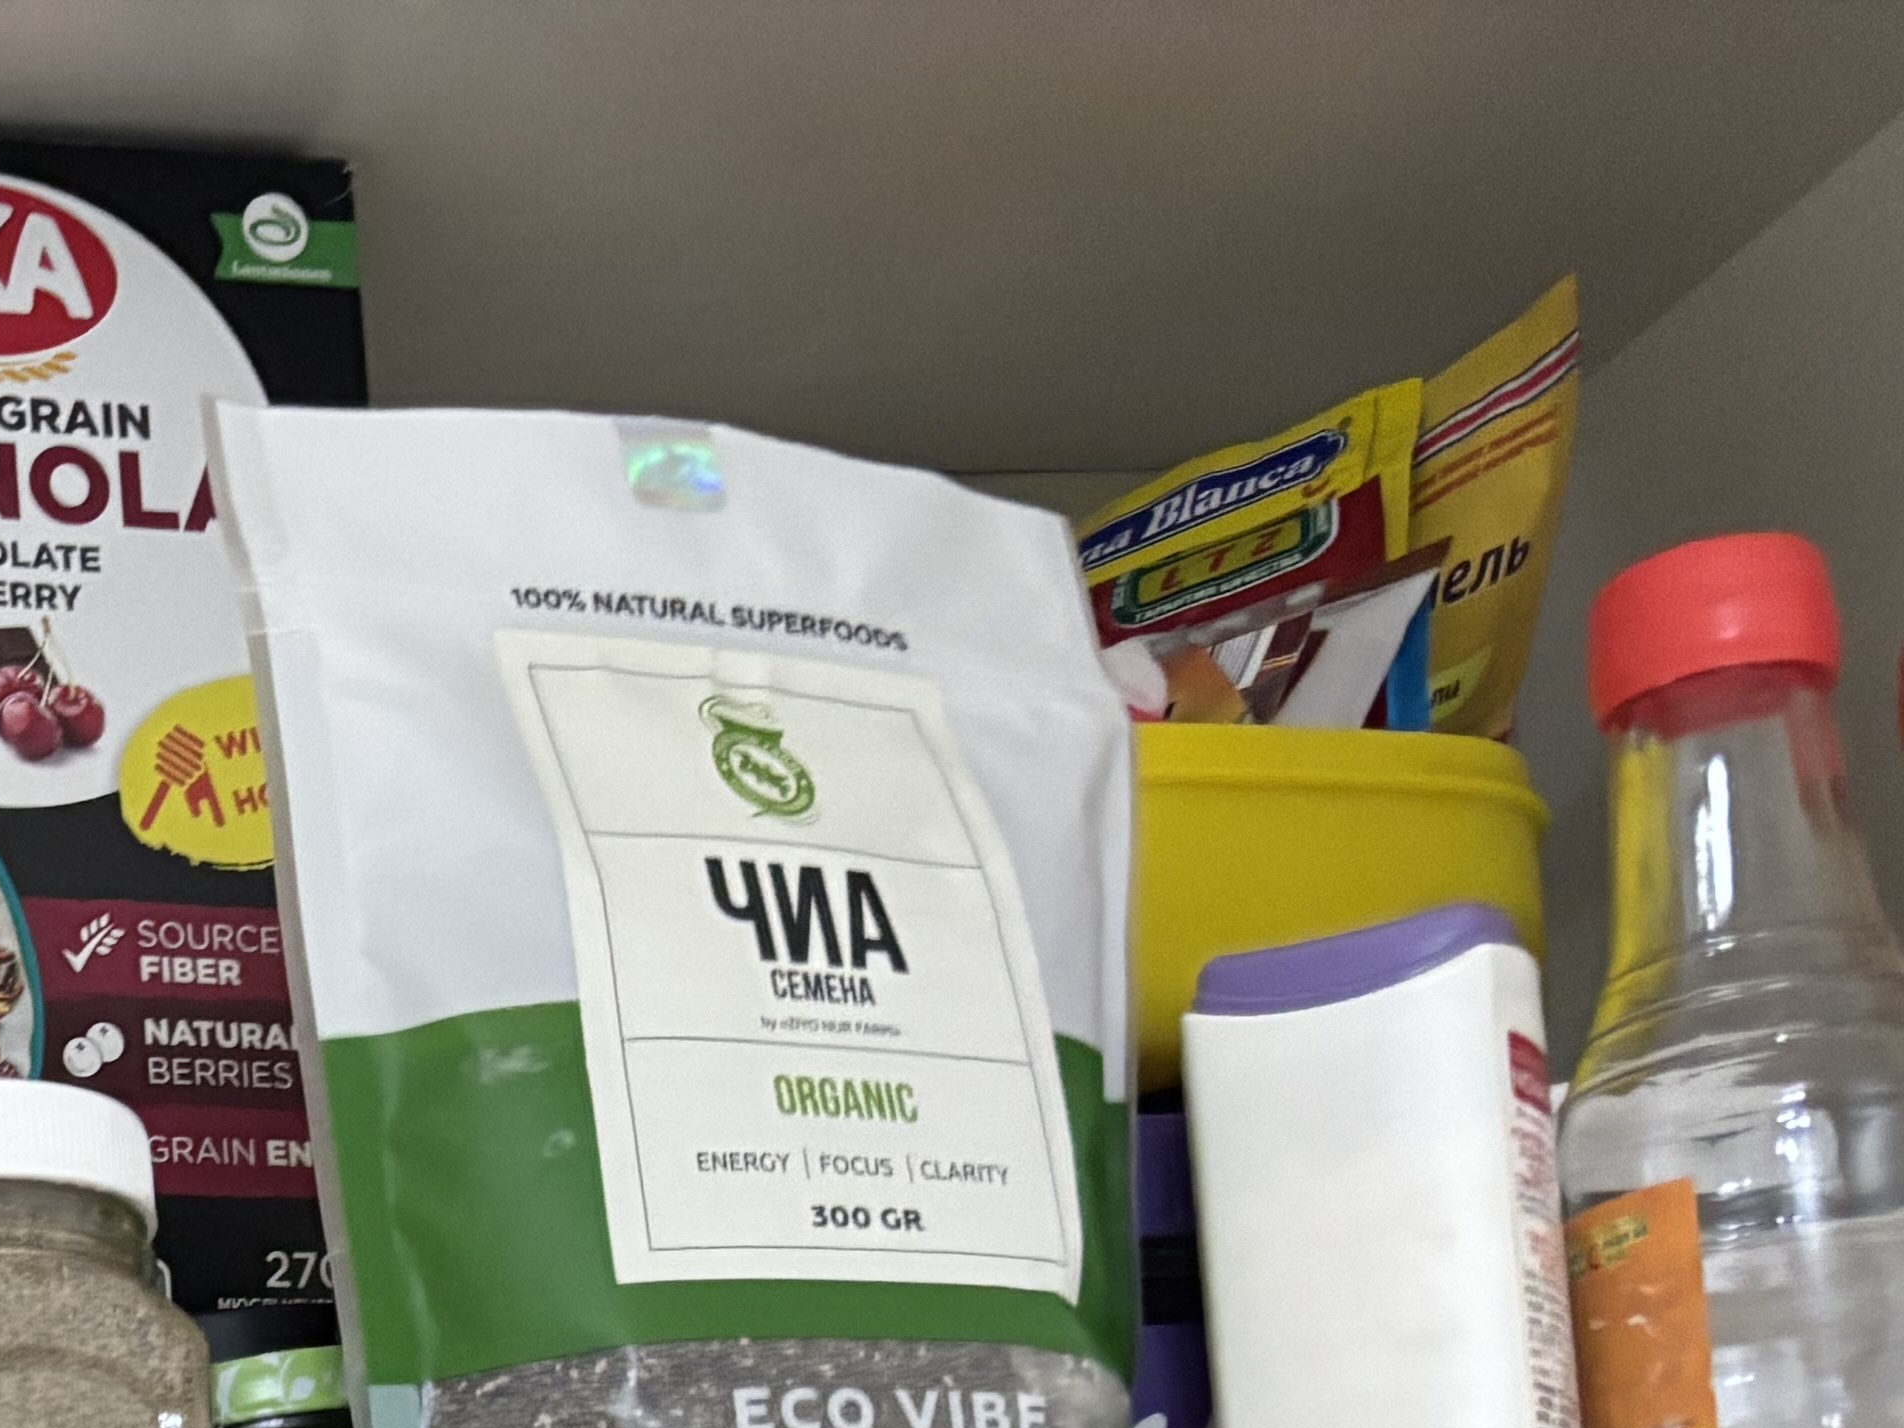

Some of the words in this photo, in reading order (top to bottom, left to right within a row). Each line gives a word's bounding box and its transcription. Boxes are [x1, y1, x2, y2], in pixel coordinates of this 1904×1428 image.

[1141, 454, 1315, 540] Blanca
[511, 588, 587, 612] 100%
[592, 592, 725, 626] NATURAL
[731, 605, 909, 651] SUPERFOODS
[704, 856, 910, 974] ЧИА
[137, 920, 281, 953] SOURCE
[140, 956, 242, 985] FIBER
[770, 969, 877, 1006] СЕМЕНА
[144, 1018, 294, 1050] NATURA
[148, 1057, 293, 1090] BERRIES
[774, 1073, 919, 1124] ORGANIC
[696, 1151, 792, 1173] ENERGY
[819, 1154, 894, 1179] FOCUS
[920, 1160, 1009, 1186] CLARITY
[811, 1205, 871, 1230] 300
[881, 1206, 925, 1231] GR
